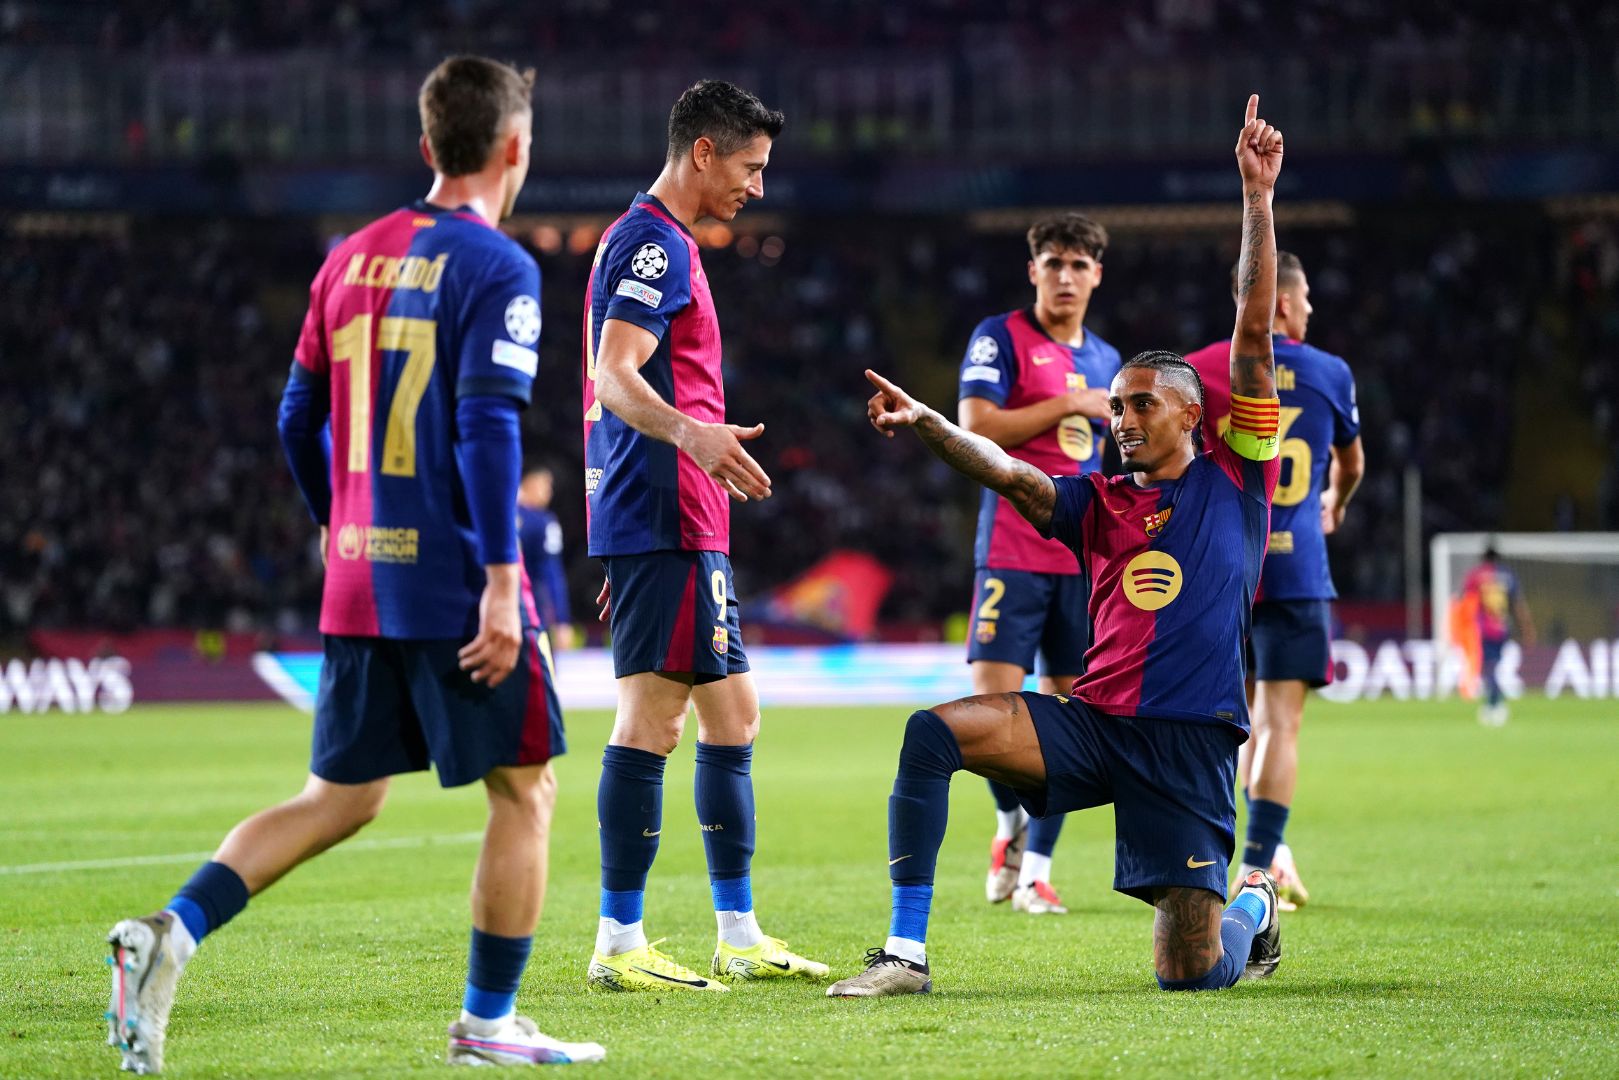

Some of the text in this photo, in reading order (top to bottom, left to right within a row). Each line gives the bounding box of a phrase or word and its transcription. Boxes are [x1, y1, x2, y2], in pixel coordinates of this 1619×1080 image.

[332, 312, 437, 478] 17
[711, 569, 727, 622] 9
[978, 577, 1006, 620] 2
